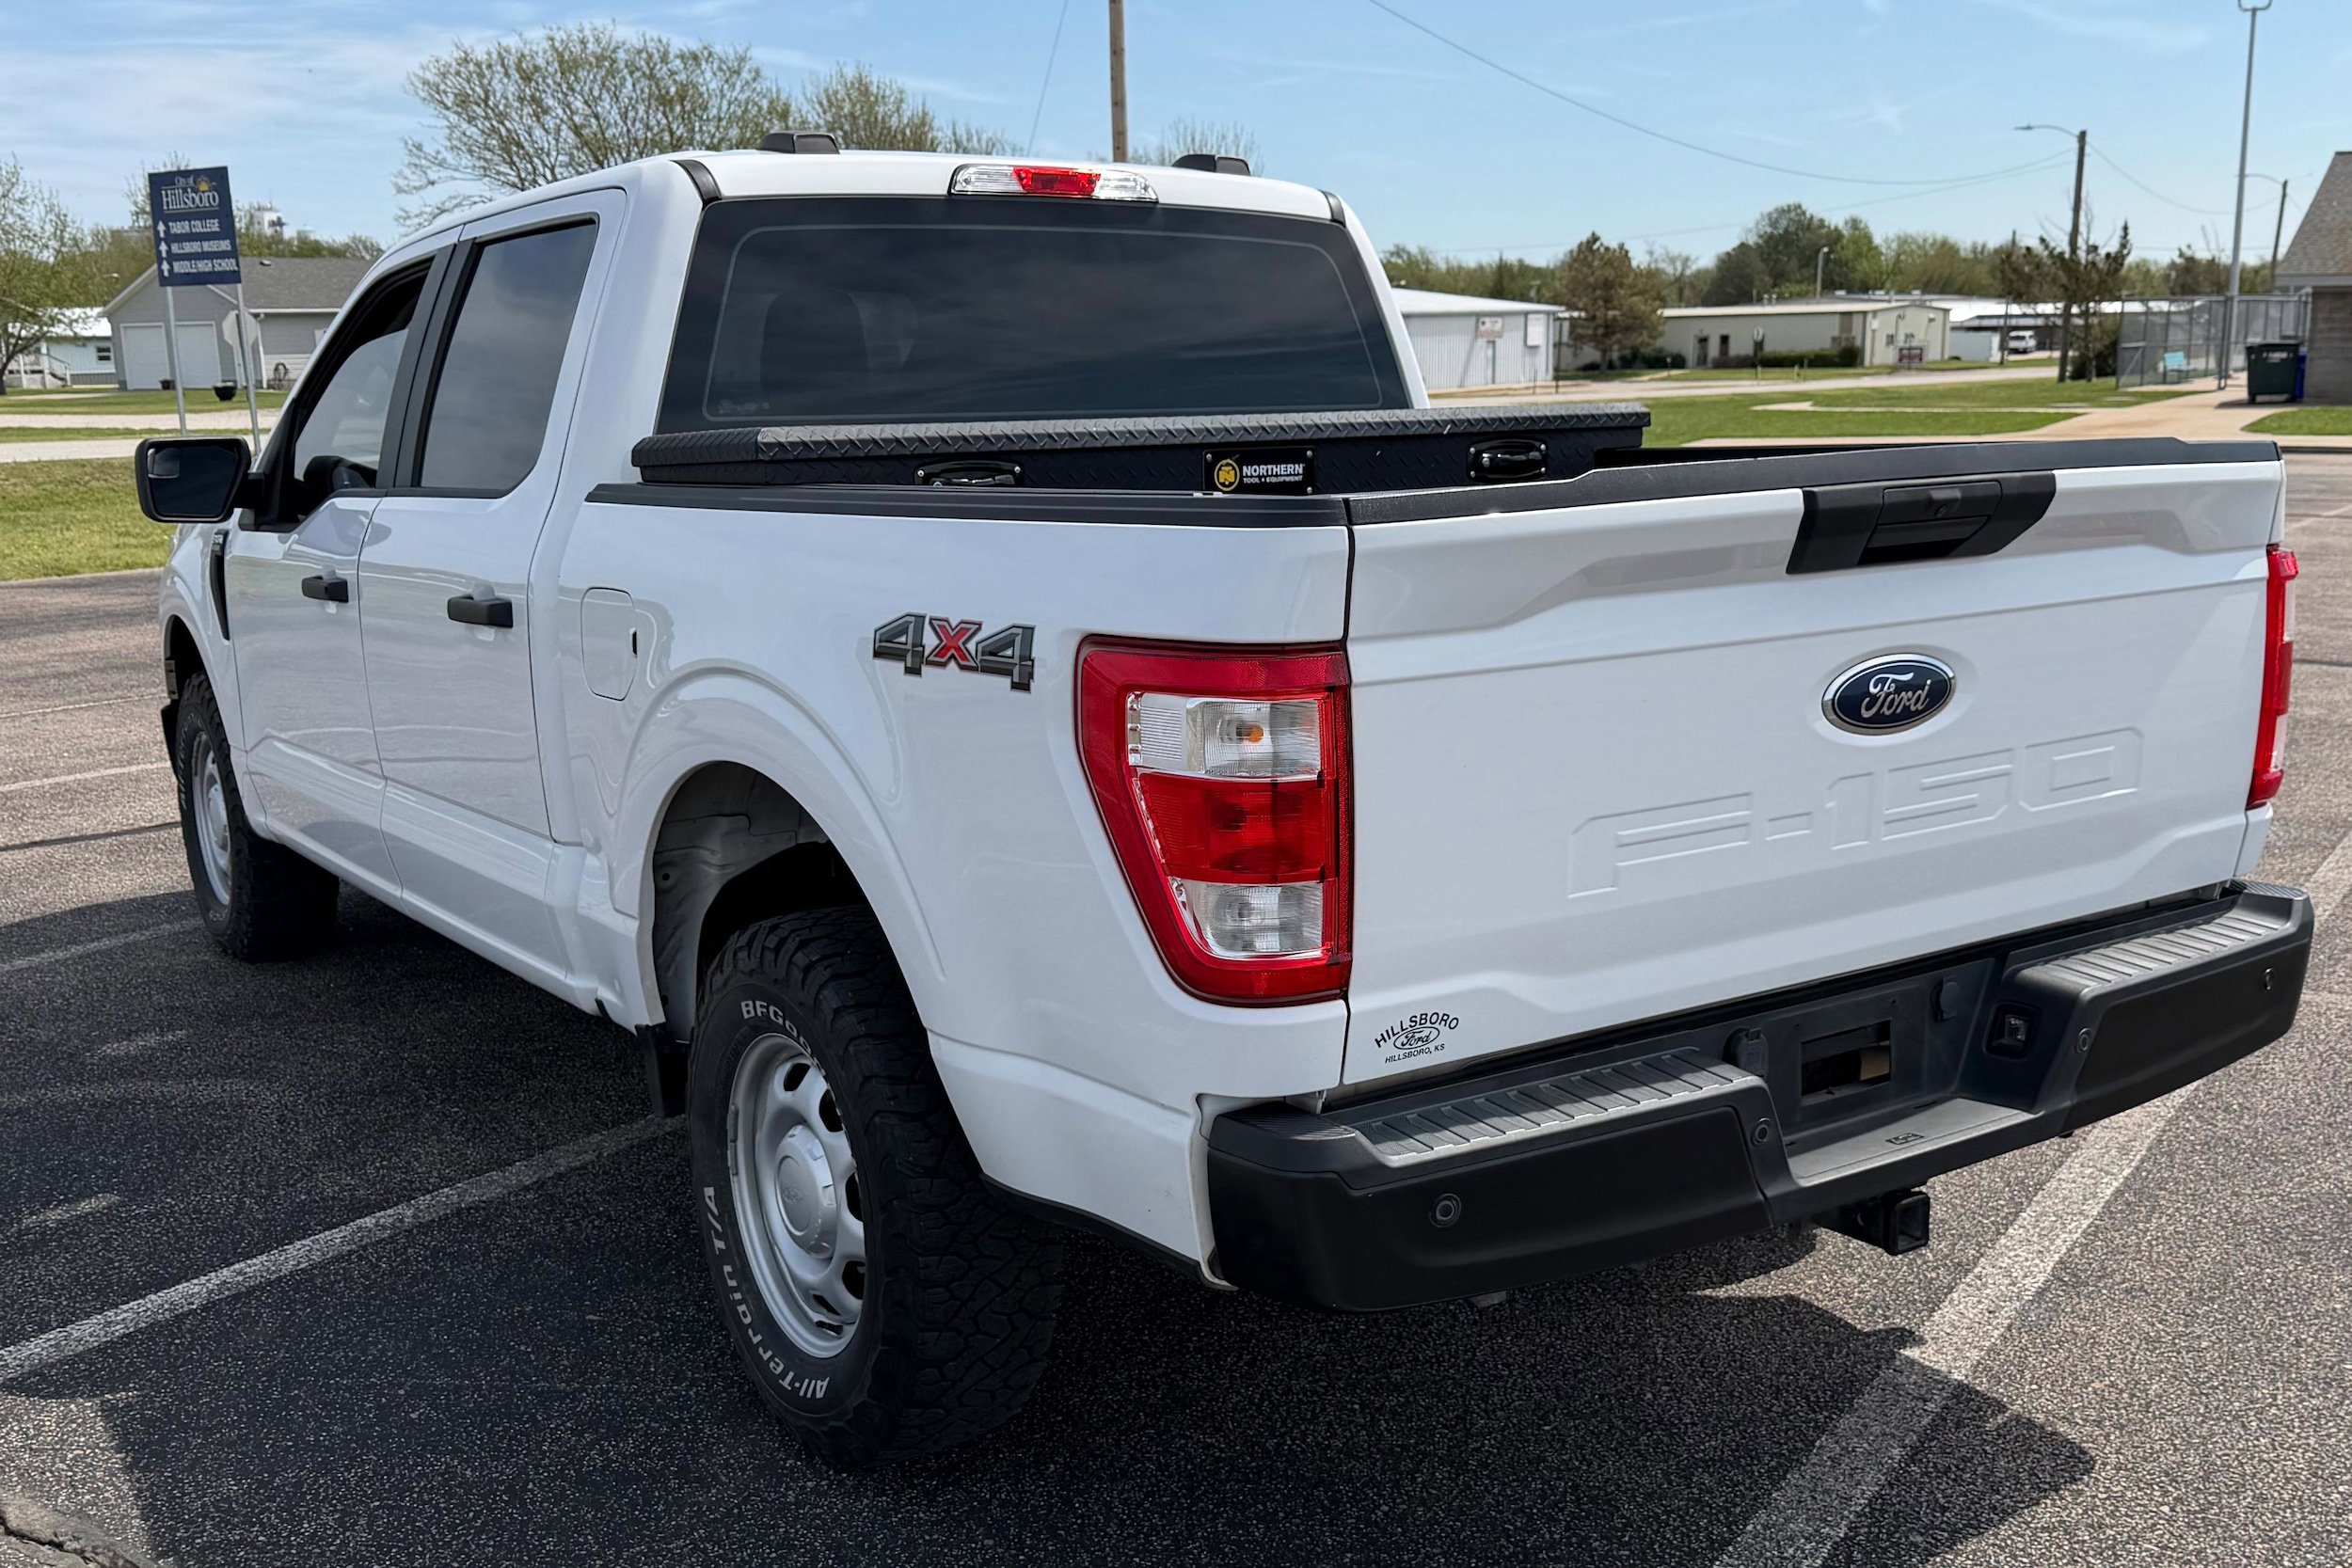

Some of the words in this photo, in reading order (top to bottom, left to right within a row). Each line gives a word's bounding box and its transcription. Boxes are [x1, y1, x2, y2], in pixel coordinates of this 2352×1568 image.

[161, 187, 219, 210] Hillsboro
[191, 218, 220, 232] COLLEGE
[214, 259, 238, 271] SCHOOL
[1242, 463, 1305, 477] NORTHERN
[1265, 475, 1303, 483] EQUIPMENT
[1860, 672, 1931, 720] Ford
[1567, 726, 2145, 899] F-150
[1375, 1012, 1459, 1048] HILLSBORO
[1401, 1030, 1432, 1047] Ford
[1385, 1047, 1432, 1064] HILLSBORO,
